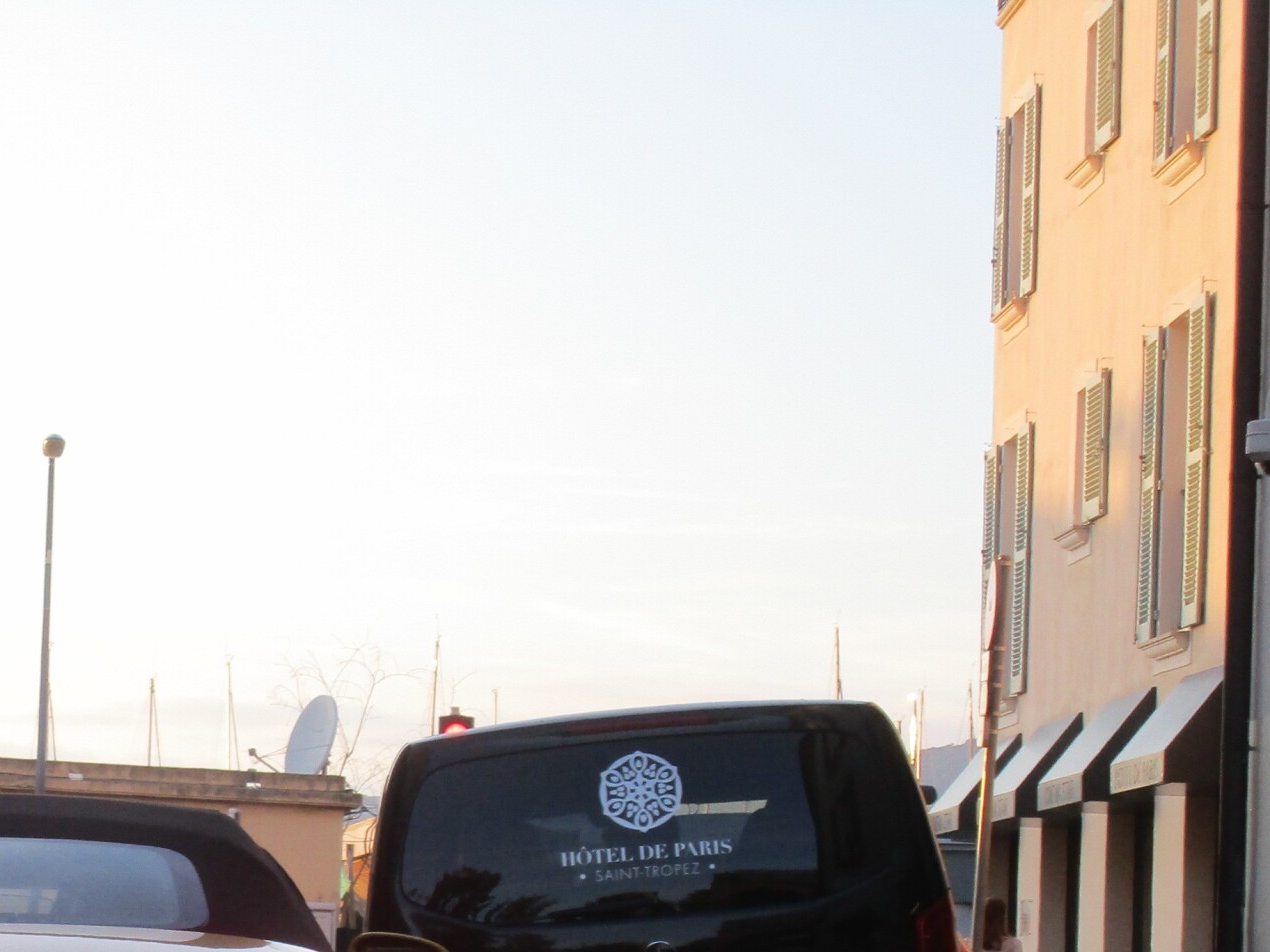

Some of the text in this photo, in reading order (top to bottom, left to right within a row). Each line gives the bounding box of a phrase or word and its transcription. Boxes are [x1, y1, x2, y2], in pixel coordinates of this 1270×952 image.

[560, 839, 733, 867] HÔTEL DE PARIS
[595, 862, 701, 882] SAINT-TROPEZ
